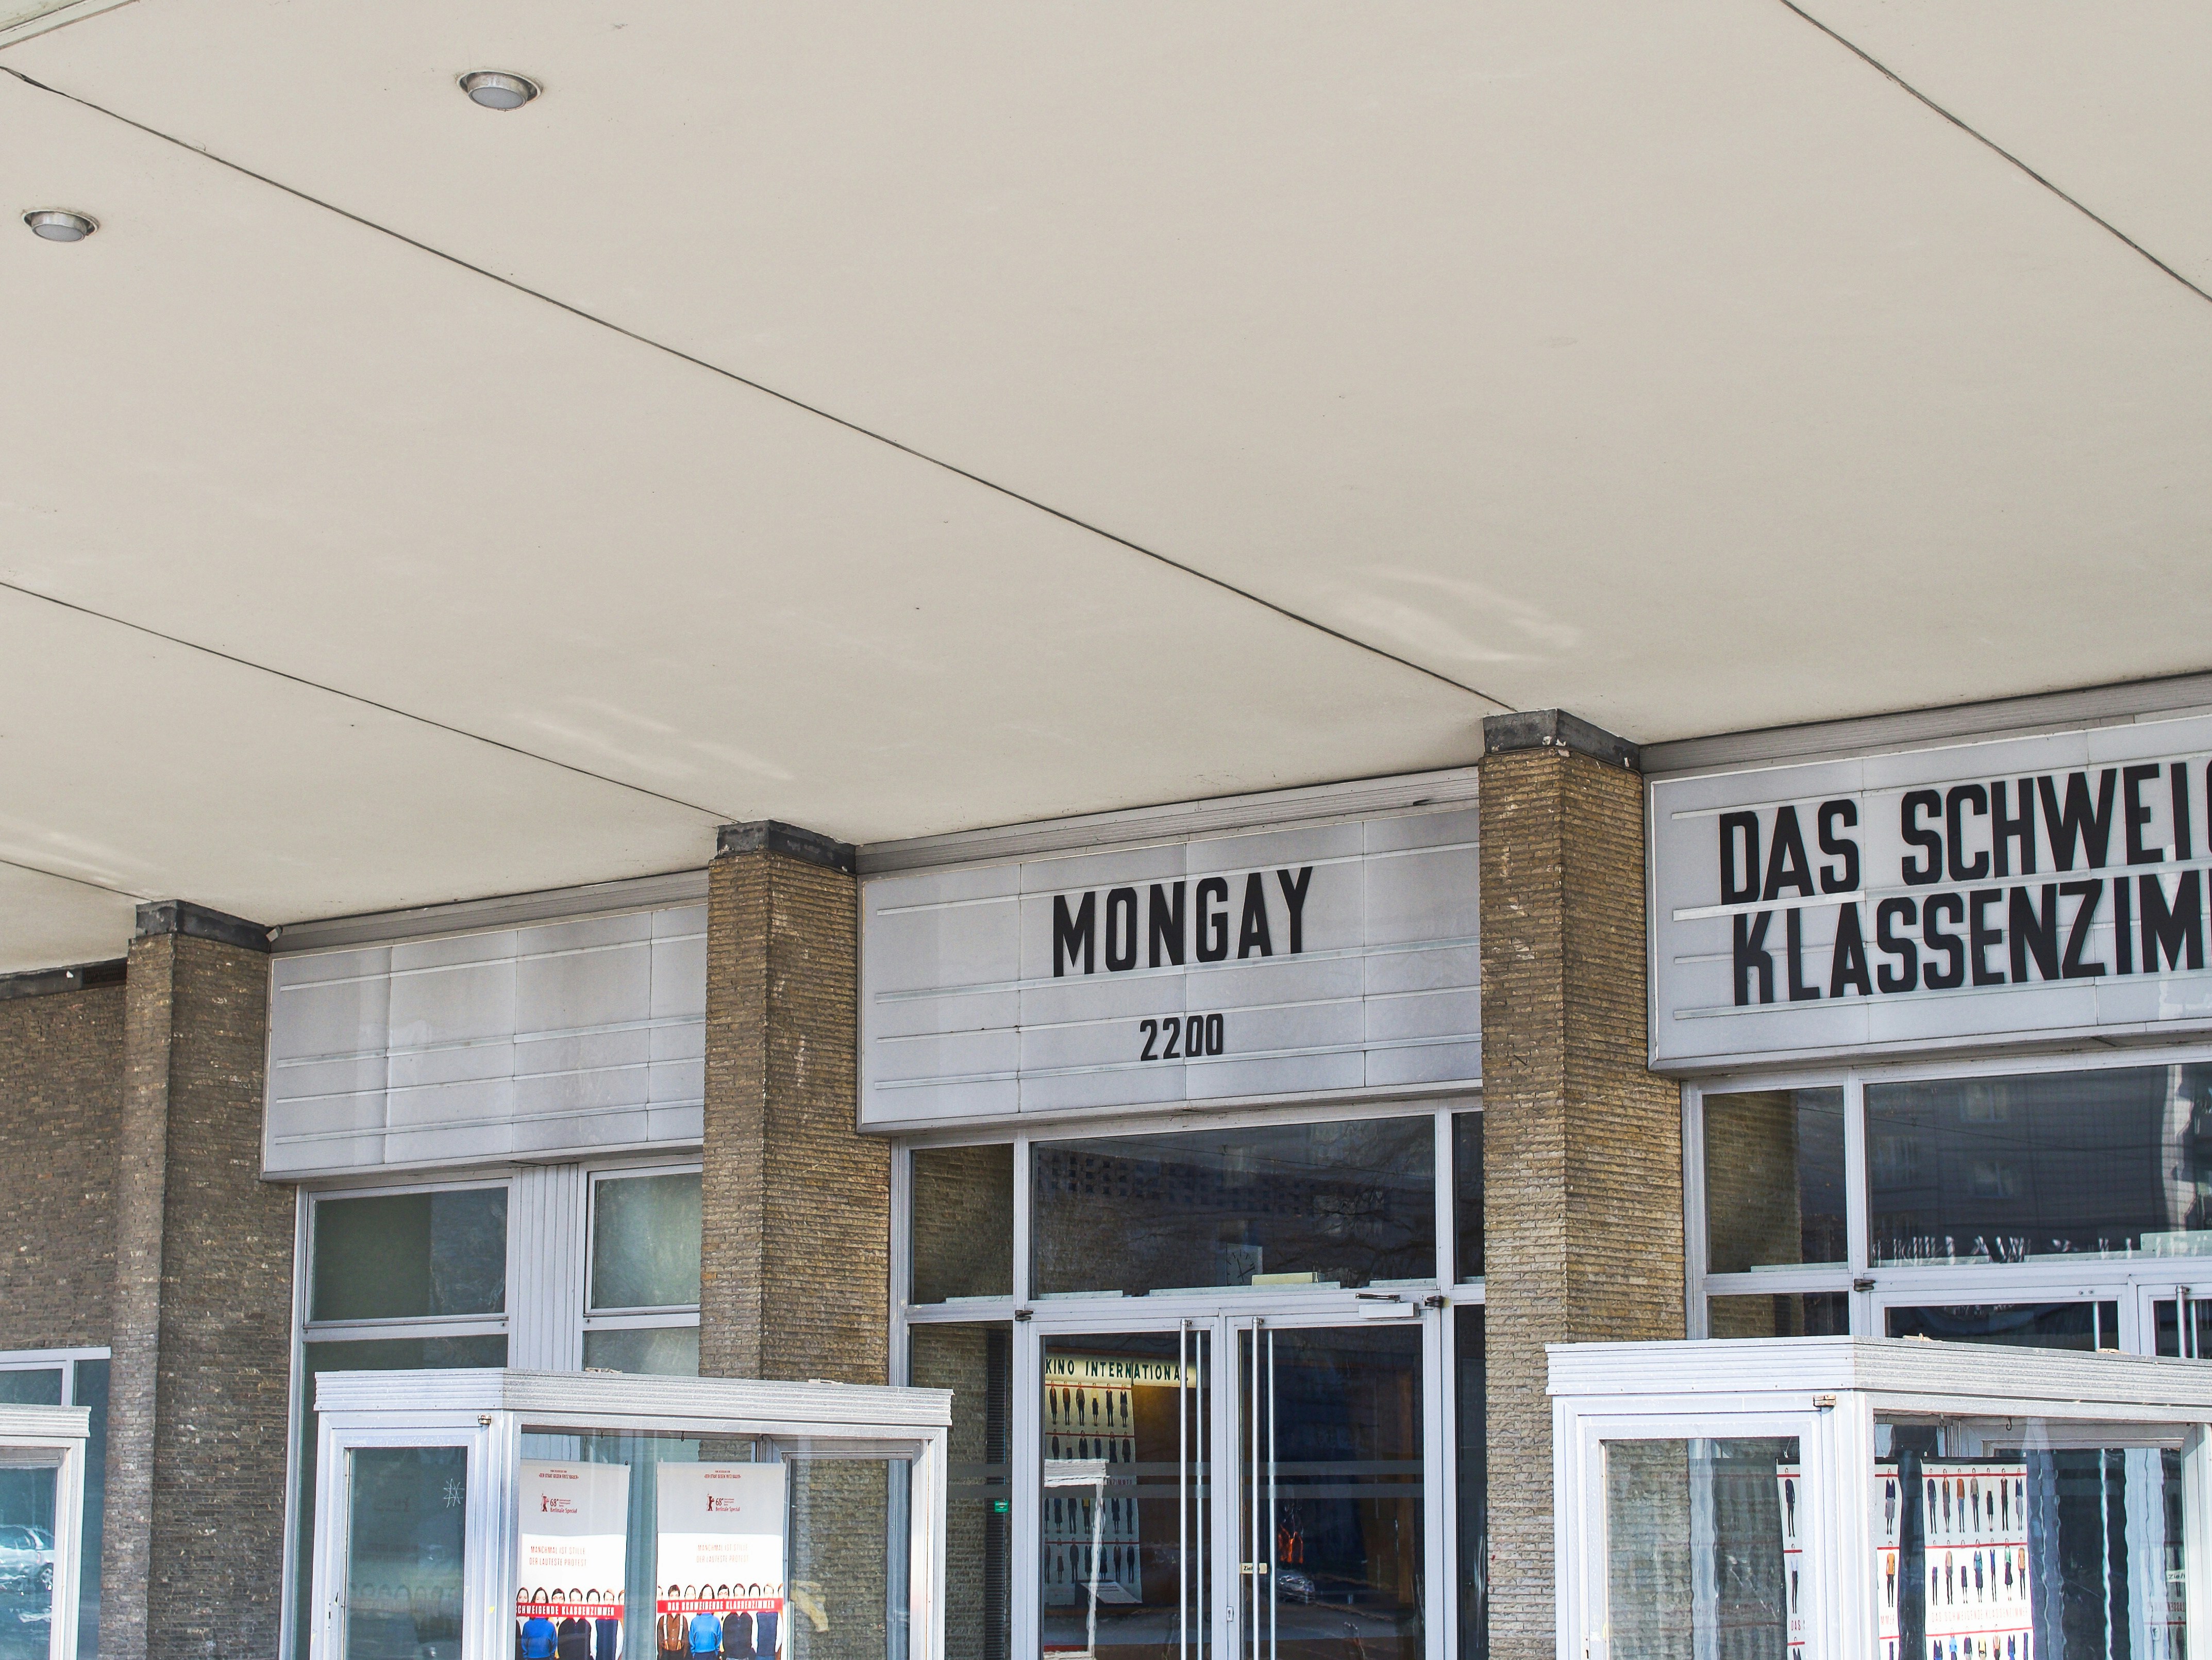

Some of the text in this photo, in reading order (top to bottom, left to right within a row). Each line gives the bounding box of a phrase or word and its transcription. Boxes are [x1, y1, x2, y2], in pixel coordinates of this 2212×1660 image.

[1719, 760, 2212, 906] DAS SCHWEI
[1053, 866, 1313, 978] MONGAY
[1733, 868, 2212, 1007] KLASSENZIM
[1139, 1013, 1224, 1061] 2200
[1046, 1359, 1188, 1381] KINO INTERNATIONA
[539, 1558, 563, 1566] LAUTESTE
[564, 1558, 586, 1567] PROTEST
[516, 1605, 615, 1616] CHWEIGENDE KLASSENZIMMER
[667, 1600, 775, 1611] DAS SCHWEIGENDE KLASSENZIMMER
[1791, 1620, 1801, 1631] DAS
